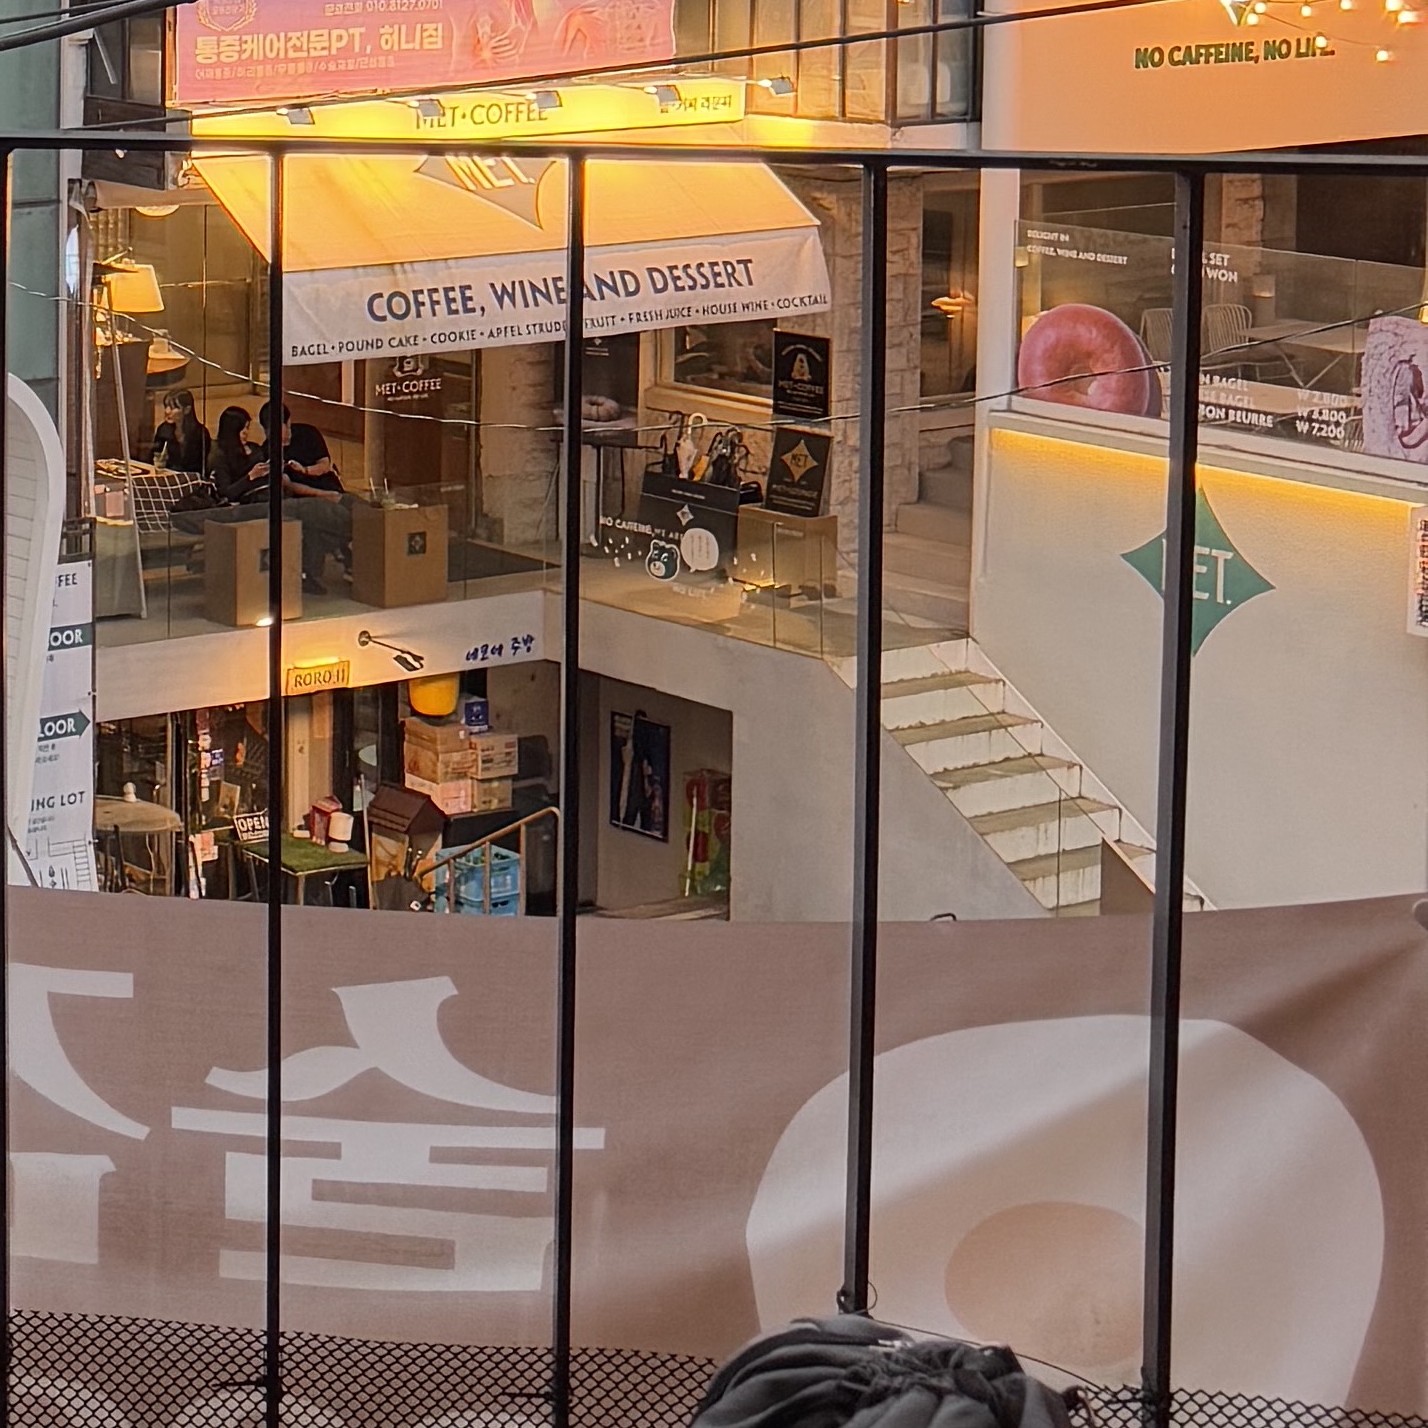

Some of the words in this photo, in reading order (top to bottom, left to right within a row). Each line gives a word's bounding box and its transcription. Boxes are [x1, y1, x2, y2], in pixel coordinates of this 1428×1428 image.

[379, 21, 443, 52] 허니짐
[1134, 47, 1164, 69] NO
[1167, 41, 1260, 65] CAFFEINE,
[1263, 38, 1292, 61] NO
[470, 101, 549, 125] COFFEE
[367, 284, 487, 322] COFFEE,
[489, 275, 568, 311] WINE
[646, 259, 754, 294] DESSERT
[291, 344, 329, 358] BAGEL
[338, 337, 383, 353] POUND
[388, 335, 419, 349] CAKE
[430, 329, 477, 344] COOKIE
[628, 306, 663, 323] FRESH
[702, 302, 737, 317] HOUSE
[741, 299, 768, 313] WINE
[776, 294, 828, 309] COCKTAIL
[402, 378, 442, 393] COFFEE
[57, 573, 78, 587] FEE
[1162, 538, 1233, 605] ET.
[49, 629, 84, 647] OOR
[38, 717, 77, 738] LOOR
[60, 791, 86, 807] LOT
[237, 815, 270, 832] OPEN
